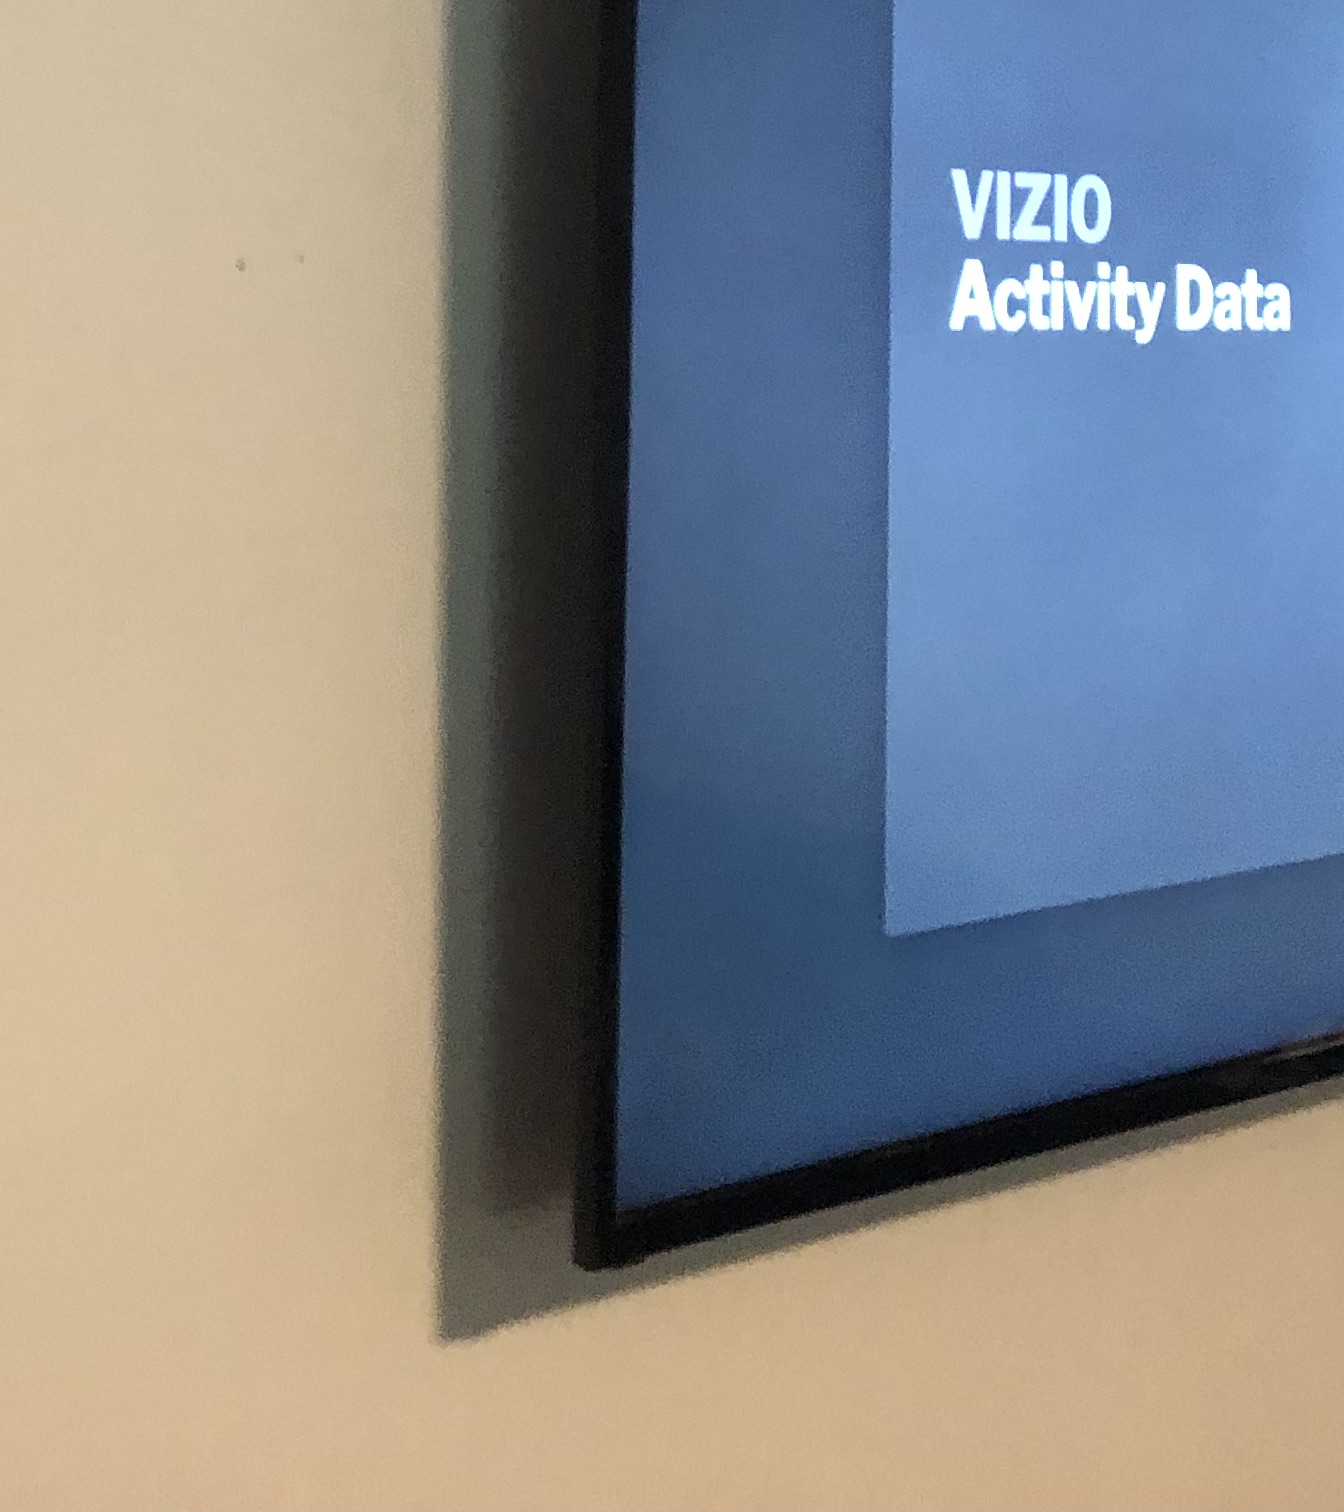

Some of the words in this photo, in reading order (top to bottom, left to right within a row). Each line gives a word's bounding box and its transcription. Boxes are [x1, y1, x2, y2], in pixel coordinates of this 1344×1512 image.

[950, 168, 1112, 244] VIZIO
[949, 258, 1166, 345] Activity
[1175, 263, 1291, 331] Data
